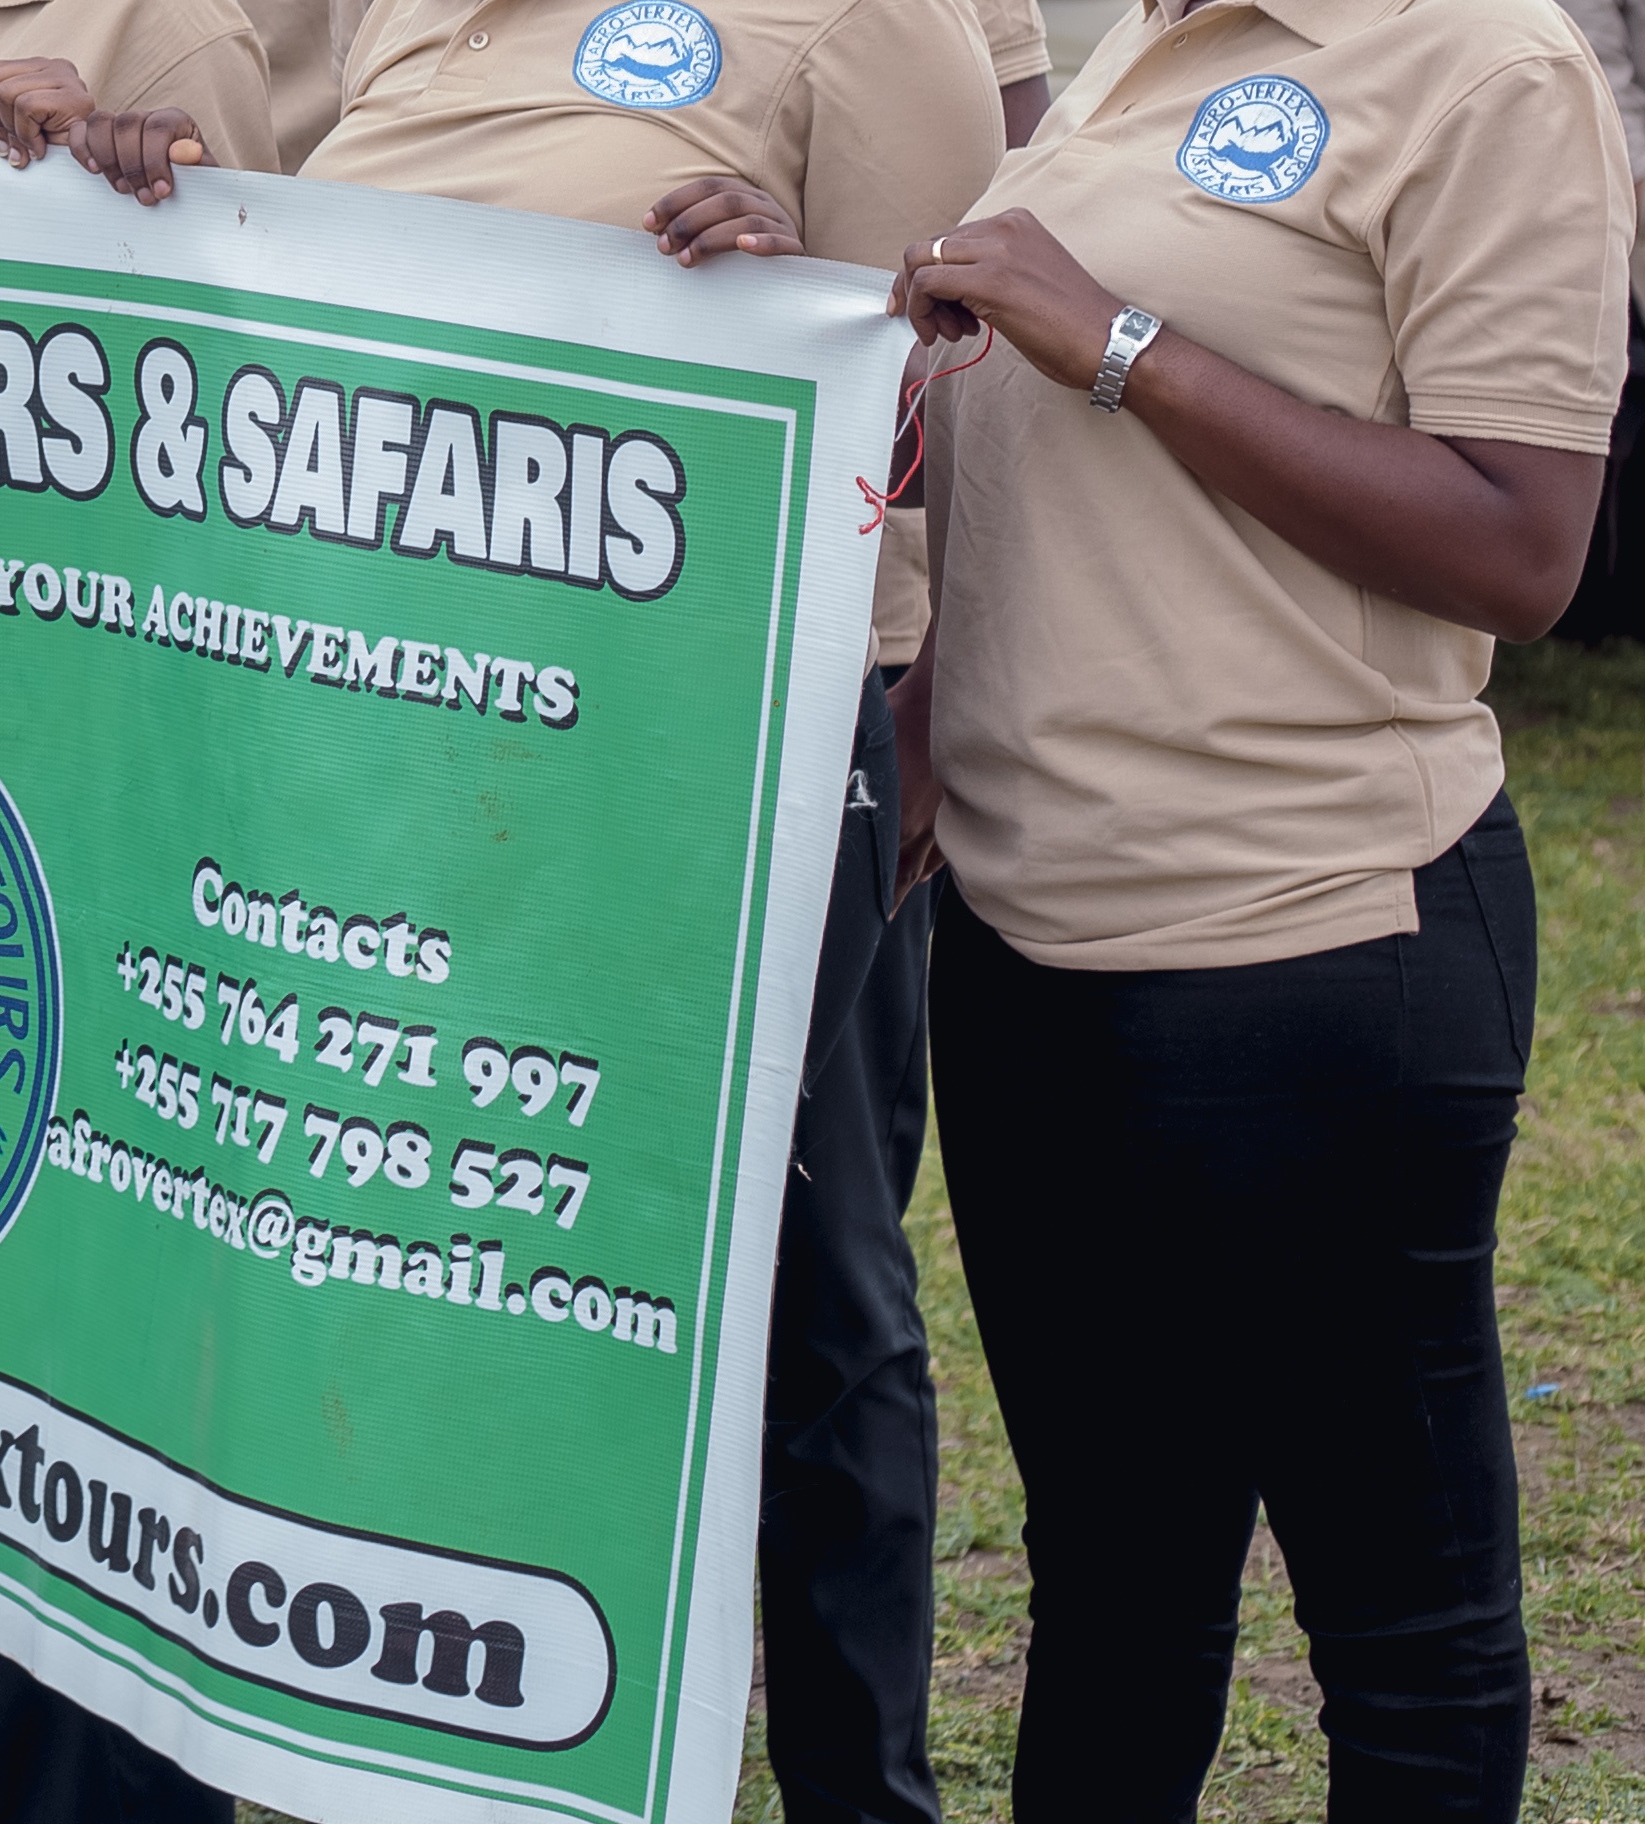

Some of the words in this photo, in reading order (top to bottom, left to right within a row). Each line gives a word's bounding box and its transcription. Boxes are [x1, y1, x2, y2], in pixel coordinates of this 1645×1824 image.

[588, 5, 697, 56] AFRO-VERTEX
[681, 30, 713, 93] TOURS
[1198, 82, 1310, 142] AFRO-VERTEX
[1283, 121, 1320, 182] TOURS
[133, 339, 210, 519] &
[218, 365, 685, 601] SAFARIS
[140, 583, 578, 728] ACHIEVEMENTS
[192, 860, 452, 984] Contacts
[116, 942, 207, 1030] +255
[217, 975, 301, 1064] 764
[314, 1008, 439, 1087] 271
[461, 1038, 601, 1126] 997
[114, 1040, 202, 1130] +255
[211, 1073, 289, 1165] 717
[303, 1105, 433, 1189] 798
[449, 1140, 592, 1230] 527
[46, 1110, 679, 1354] afrovertex@gmail.com
